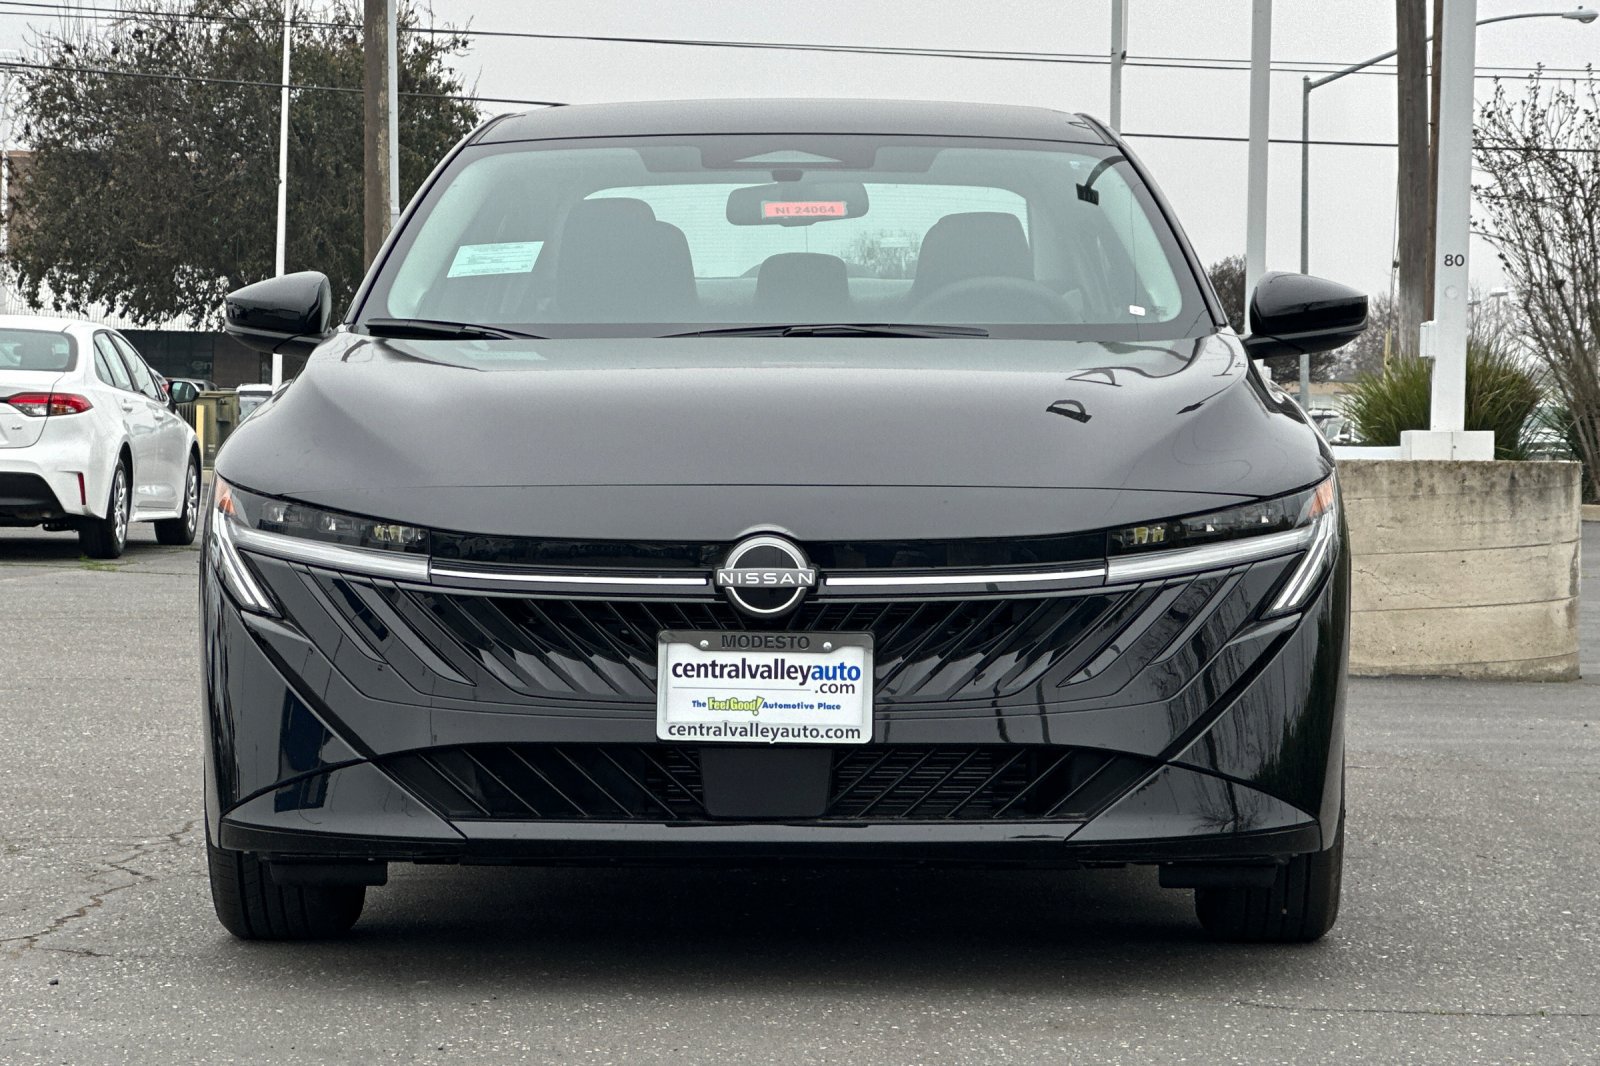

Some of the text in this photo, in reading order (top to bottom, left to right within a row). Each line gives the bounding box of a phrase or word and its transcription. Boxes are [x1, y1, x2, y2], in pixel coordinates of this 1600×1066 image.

[1444, 254, 1465, 267] 80
[719, 572, 813, 585] NISSAN
[721, 634, 810, 650] MODESTO
[671, 657, 861, 686] centralvalleyauto
[814, 682, 855, 694] .com
[692, 700, 707, 708] The
[762, 701, 814, 710] Automotive
[817, 702, 841, 710] Place
[668, 722, 861, 741] centralvalleyauto.com
